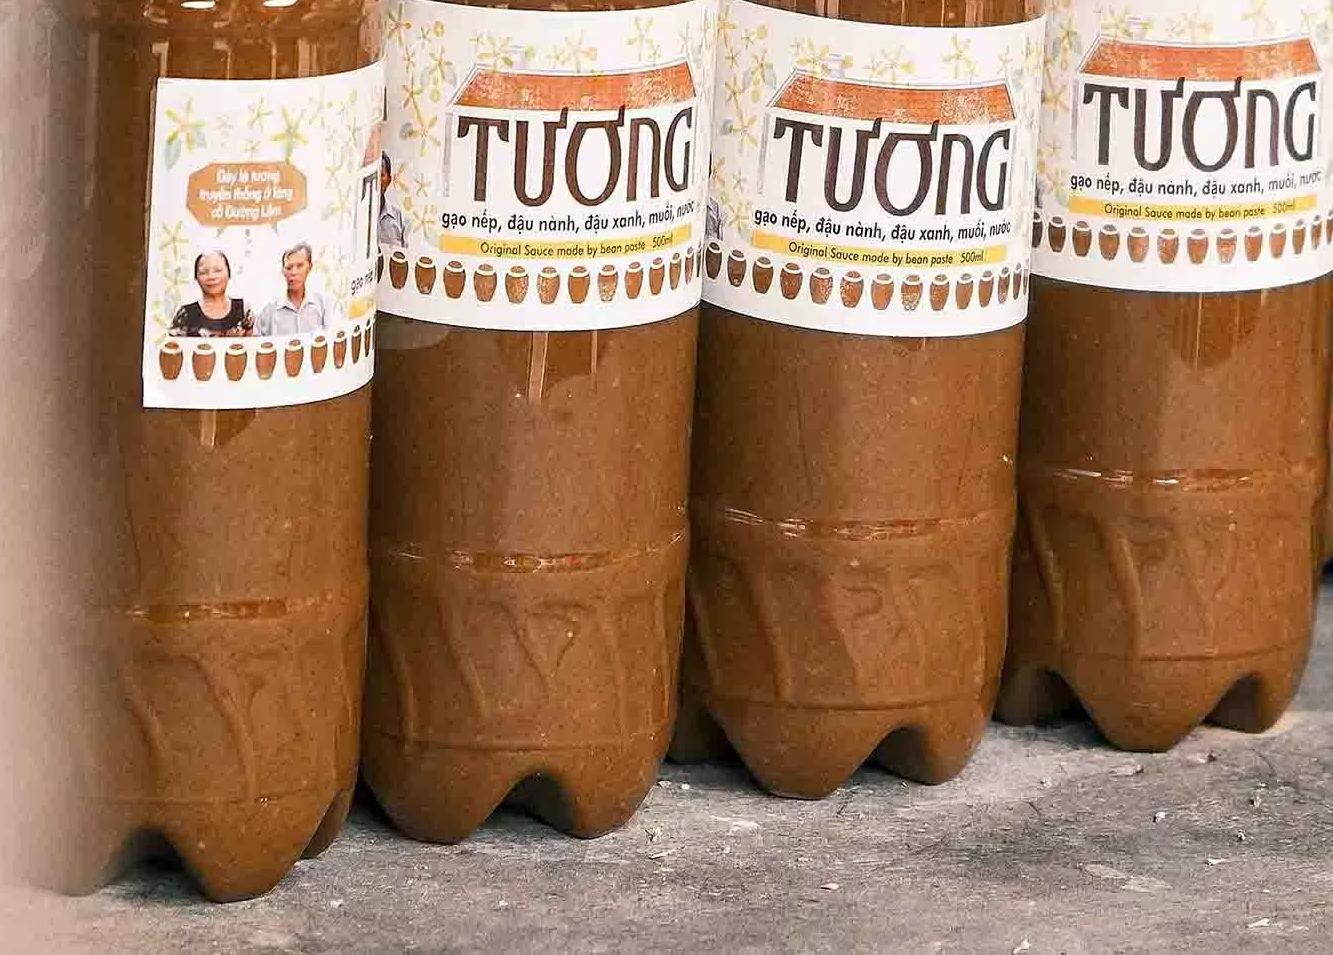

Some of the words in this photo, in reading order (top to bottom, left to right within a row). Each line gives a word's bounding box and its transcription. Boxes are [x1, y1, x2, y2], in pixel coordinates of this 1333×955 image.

[1082, 76, 1317, 172] TƯƠNG
[457, 106, 692, 207] TƯƠNG
[773, 117, 1011, 216] TƯƠNG
[1070, 174, 1092, 191] gạo
[1096, 173, 1123, 195] nếp,
[1128, 177, 1152, 197] đậu
[1157, 179, 1197, 197] nành,
[1202, 179, 1225, 199] đậu
[1230, 177, 1264, 194] xanh,
[442, 213, 466, 229] gạo
[472, 209, 501, 233] nếp,
[508, 214, 533, 234] đậu
[539, 214, 579, 233] nành,
[585, 214, 608, 234] đậu
[612, 209, 645, 228] xanh,
[1104, 203, 1141, 217] Original
[1144, 207, 1173, 219] Sauce
[1176, 208, 1202, 219] made
[1205, 209, 1215, 221] by
[1218, 209, 1240, 219] bean
[1242, 208, 1265, 219] paste
[754, 209, 777, 227] gạo
[782, 209, 810, 233] nếp,
[815, 217, 841, 238] đậu
[845, 221, 885, 242] nành,
[891, 223, 915, 243] đậu
[919, 224, 954, 243] xanh,
[958, 218, 986, 241] muối,
[480, 242, 521, 257] Original
[524, 245, 553, 256] Sauce
[557, 245, 584, 256] made
[587, 244, 597, 258] by
[600, 242, 622, 254] bean
[624, 240, 645, 253] paste
[652, 232, 673, 248] 500ml
[789, 242, 827, 257] Original
[830, 247, 859, 261] Sauce
[862, 251, 889, 263] made
[892, 253, 902, 267] by
[906, 253, 928, 265] bean
[931, 254, 953, 267] paste
[960, 250, 984, 264] 500ml
